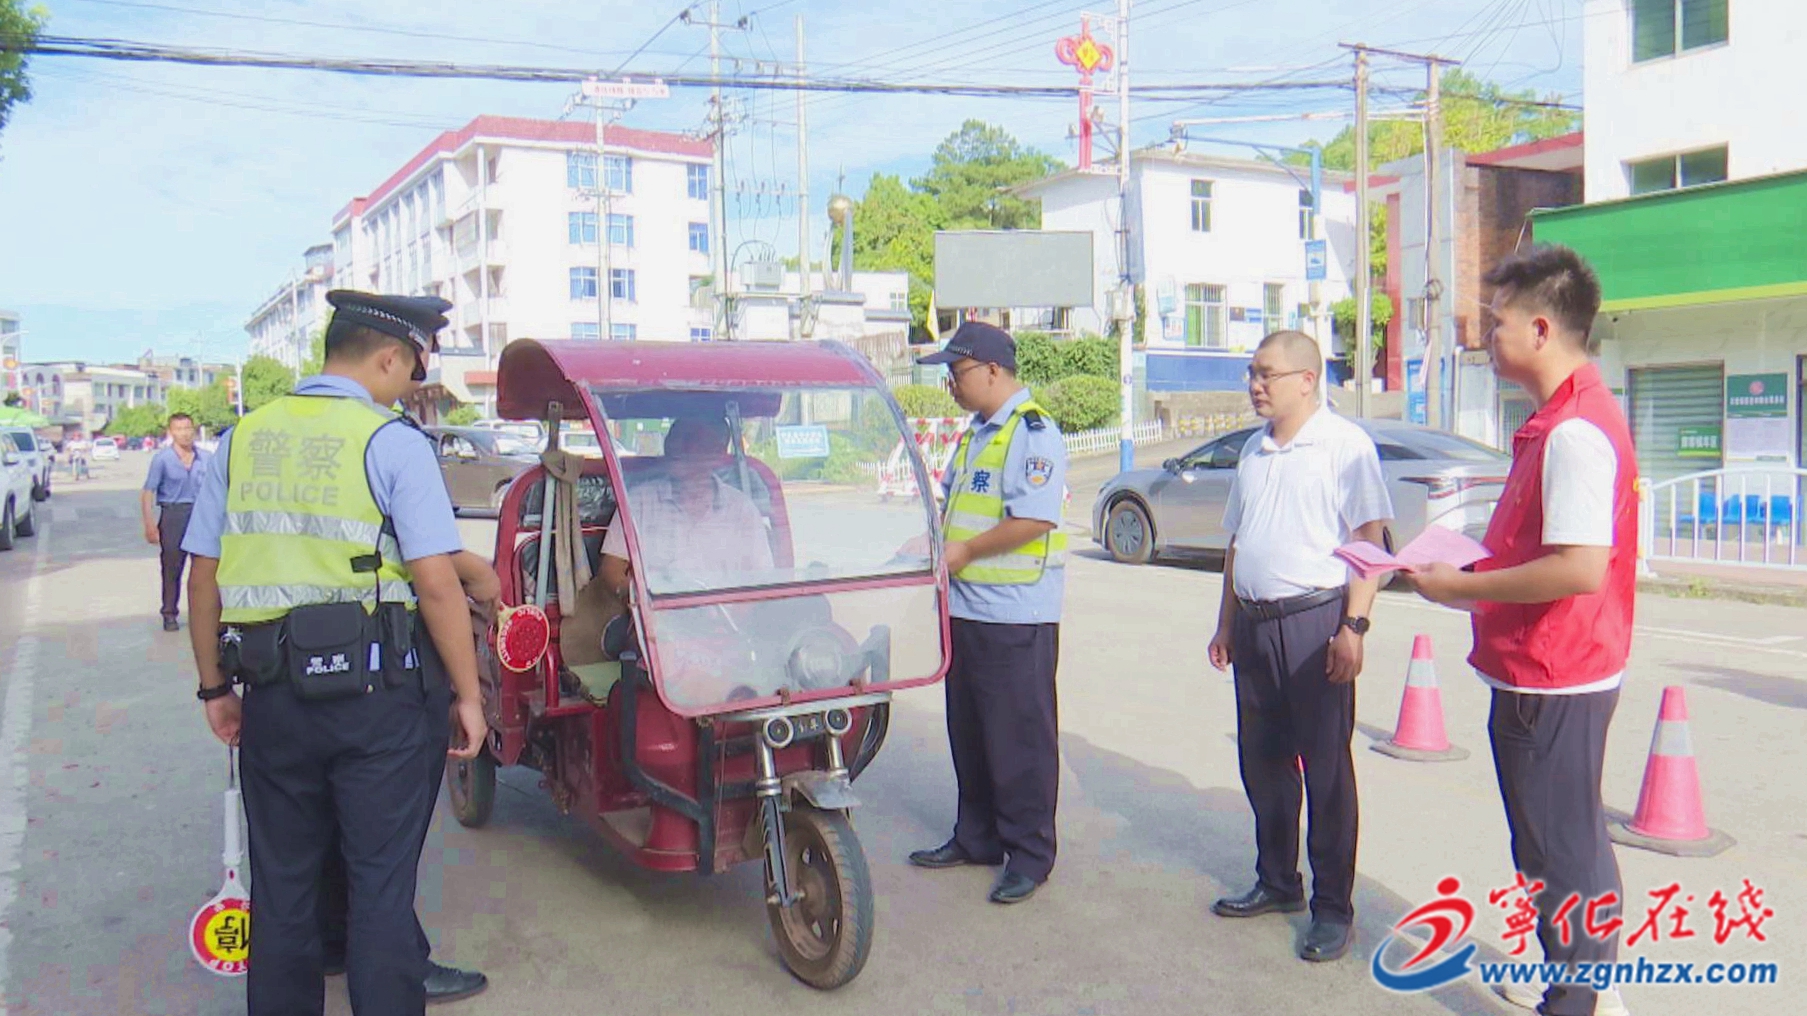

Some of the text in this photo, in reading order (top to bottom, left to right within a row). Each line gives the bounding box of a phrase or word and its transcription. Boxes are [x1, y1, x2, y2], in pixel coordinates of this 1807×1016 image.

[249, 430, 345, 480] 警察
[240, 482, 338, 506] POLICE
[306, 662, 350, 676] POLICE
[209, 959, 247, 972] TOP
